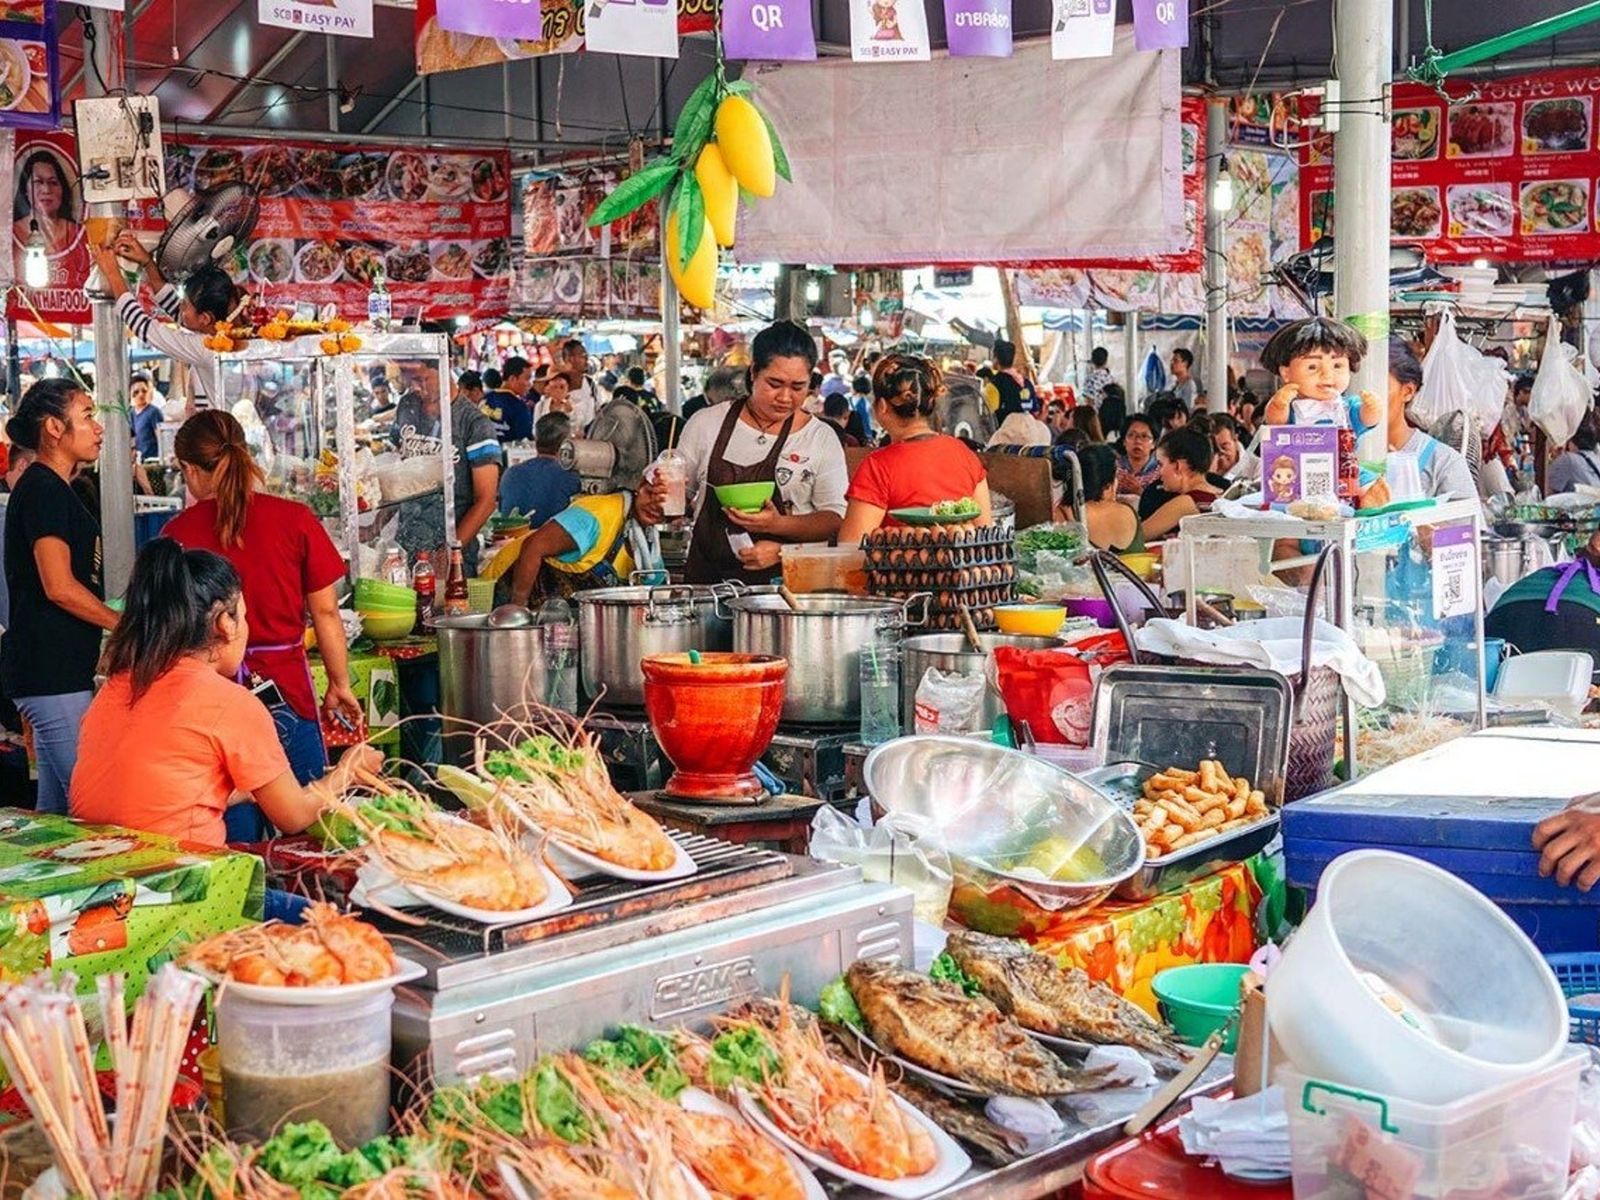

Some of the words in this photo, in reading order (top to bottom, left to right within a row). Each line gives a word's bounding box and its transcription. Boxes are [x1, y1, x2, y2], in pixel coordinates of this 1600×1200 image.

[304, 12, 332, 27] EASY
[334, 16, 357, 29] PAY
[751, 4, 784, 32] QR
[1155, 2, 1176, 25] QR
[880, 46, 901, 56] EASY
